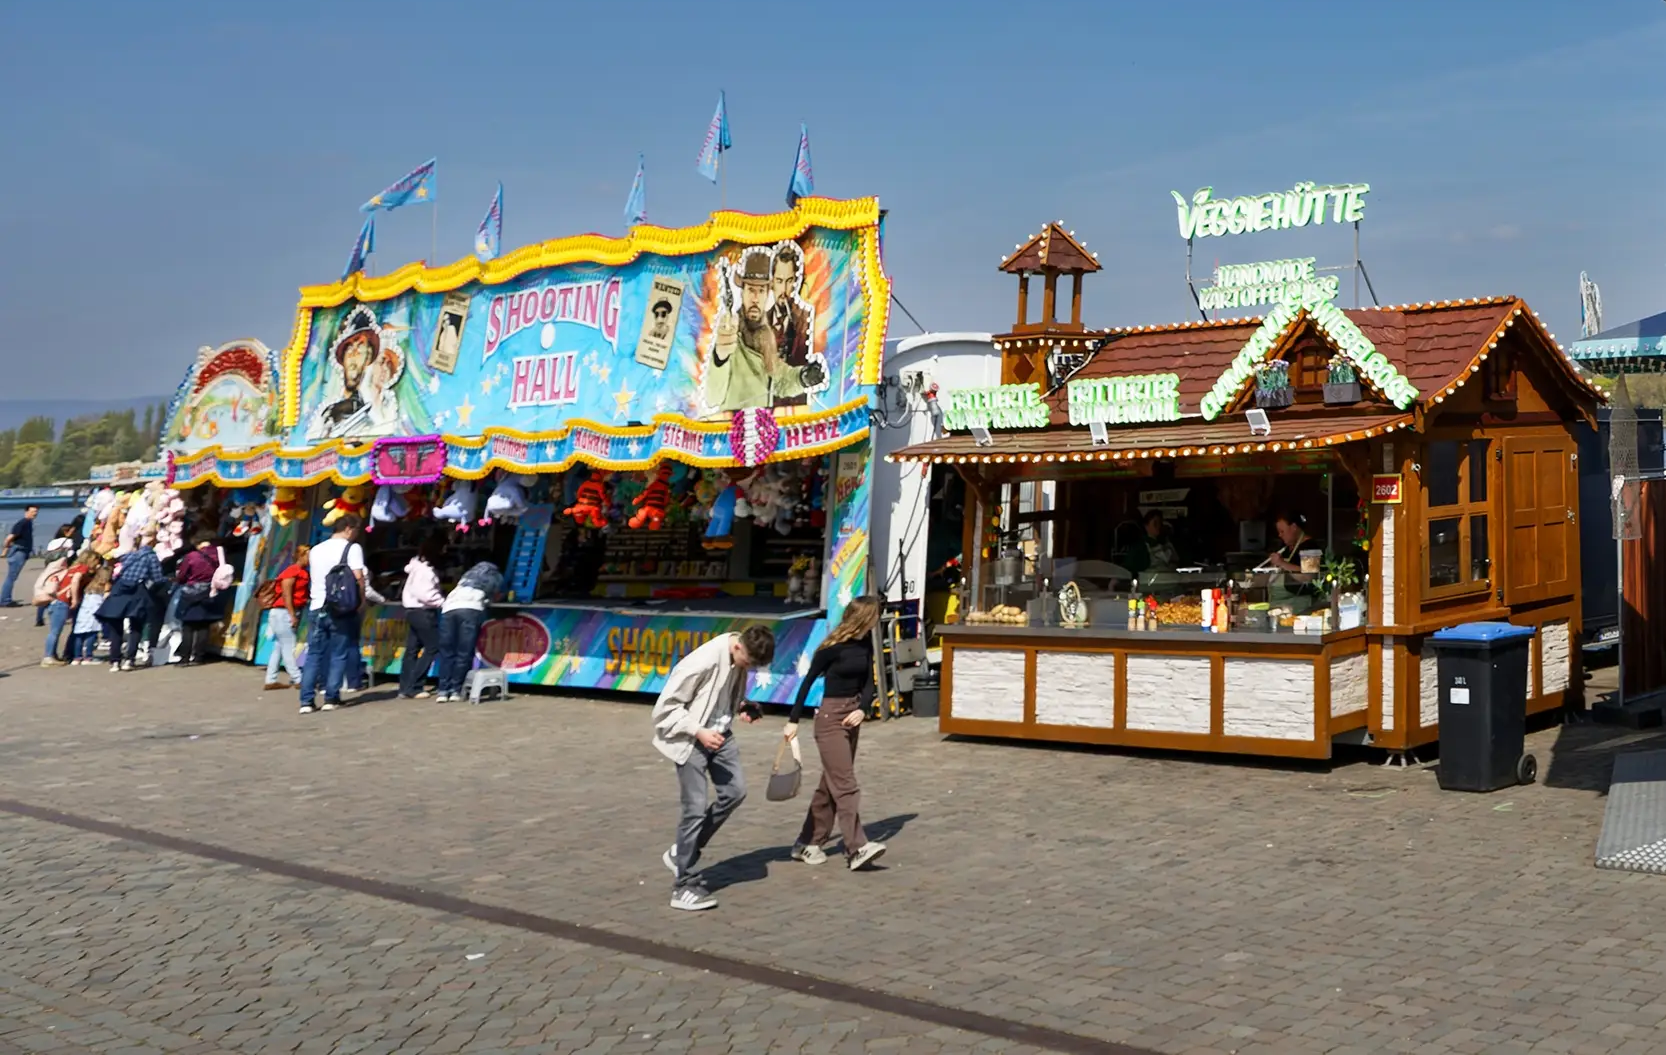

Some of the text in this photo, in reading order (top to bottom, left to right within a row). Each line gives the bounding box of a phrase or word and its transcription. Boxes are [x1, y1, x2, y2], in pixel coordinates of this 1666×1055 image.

[1170, 181, 1370, 239] VEGGIEHÜTTE
[1217, 257, 1316, 287] HANDMADE
[483, 278, 621, 357] SHOOTING
[510, 353, 578, 404] HALL
[786, 419, 840, 448] HERZ
[1376, 485, 1398, 495] 2602
